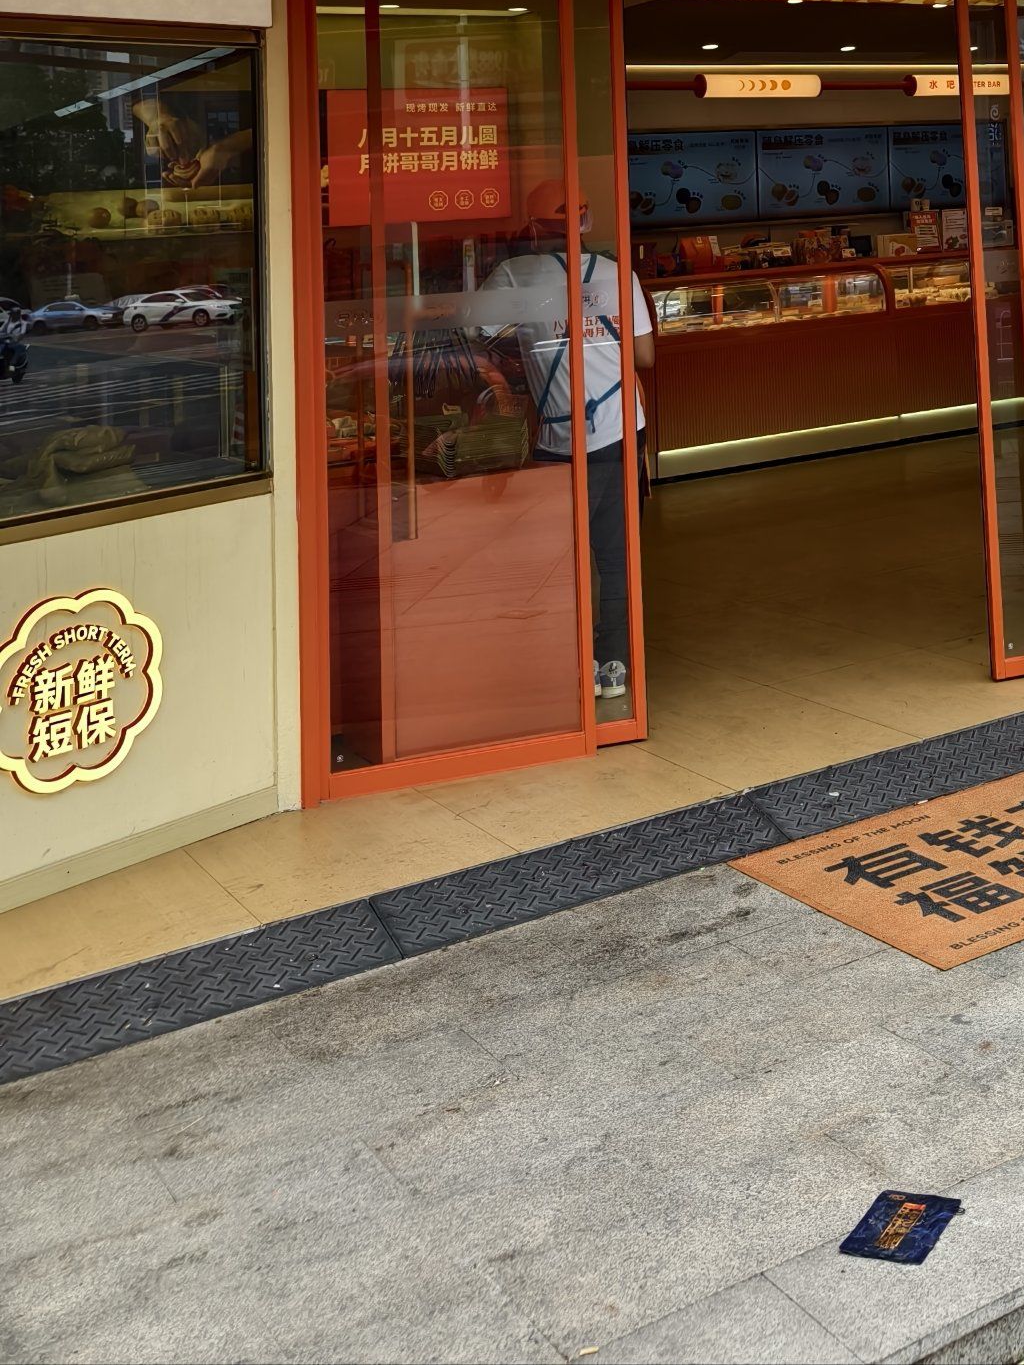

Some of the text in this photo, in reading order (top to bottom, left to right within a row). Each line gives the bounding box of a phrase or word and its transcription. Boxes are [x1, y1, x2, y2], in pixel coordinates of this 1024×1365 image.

[929, 80, 1001, 90] 水吧 TER BAR
[53, 625, 108, 650] SHORT
[33, 654, 116, 713] 新鲜
[33, 698, 117, 763] 短保
[777, 814, 931, 865] BLESSING OF THE MOON
[949, 920, 1020, 951] BLESSING
